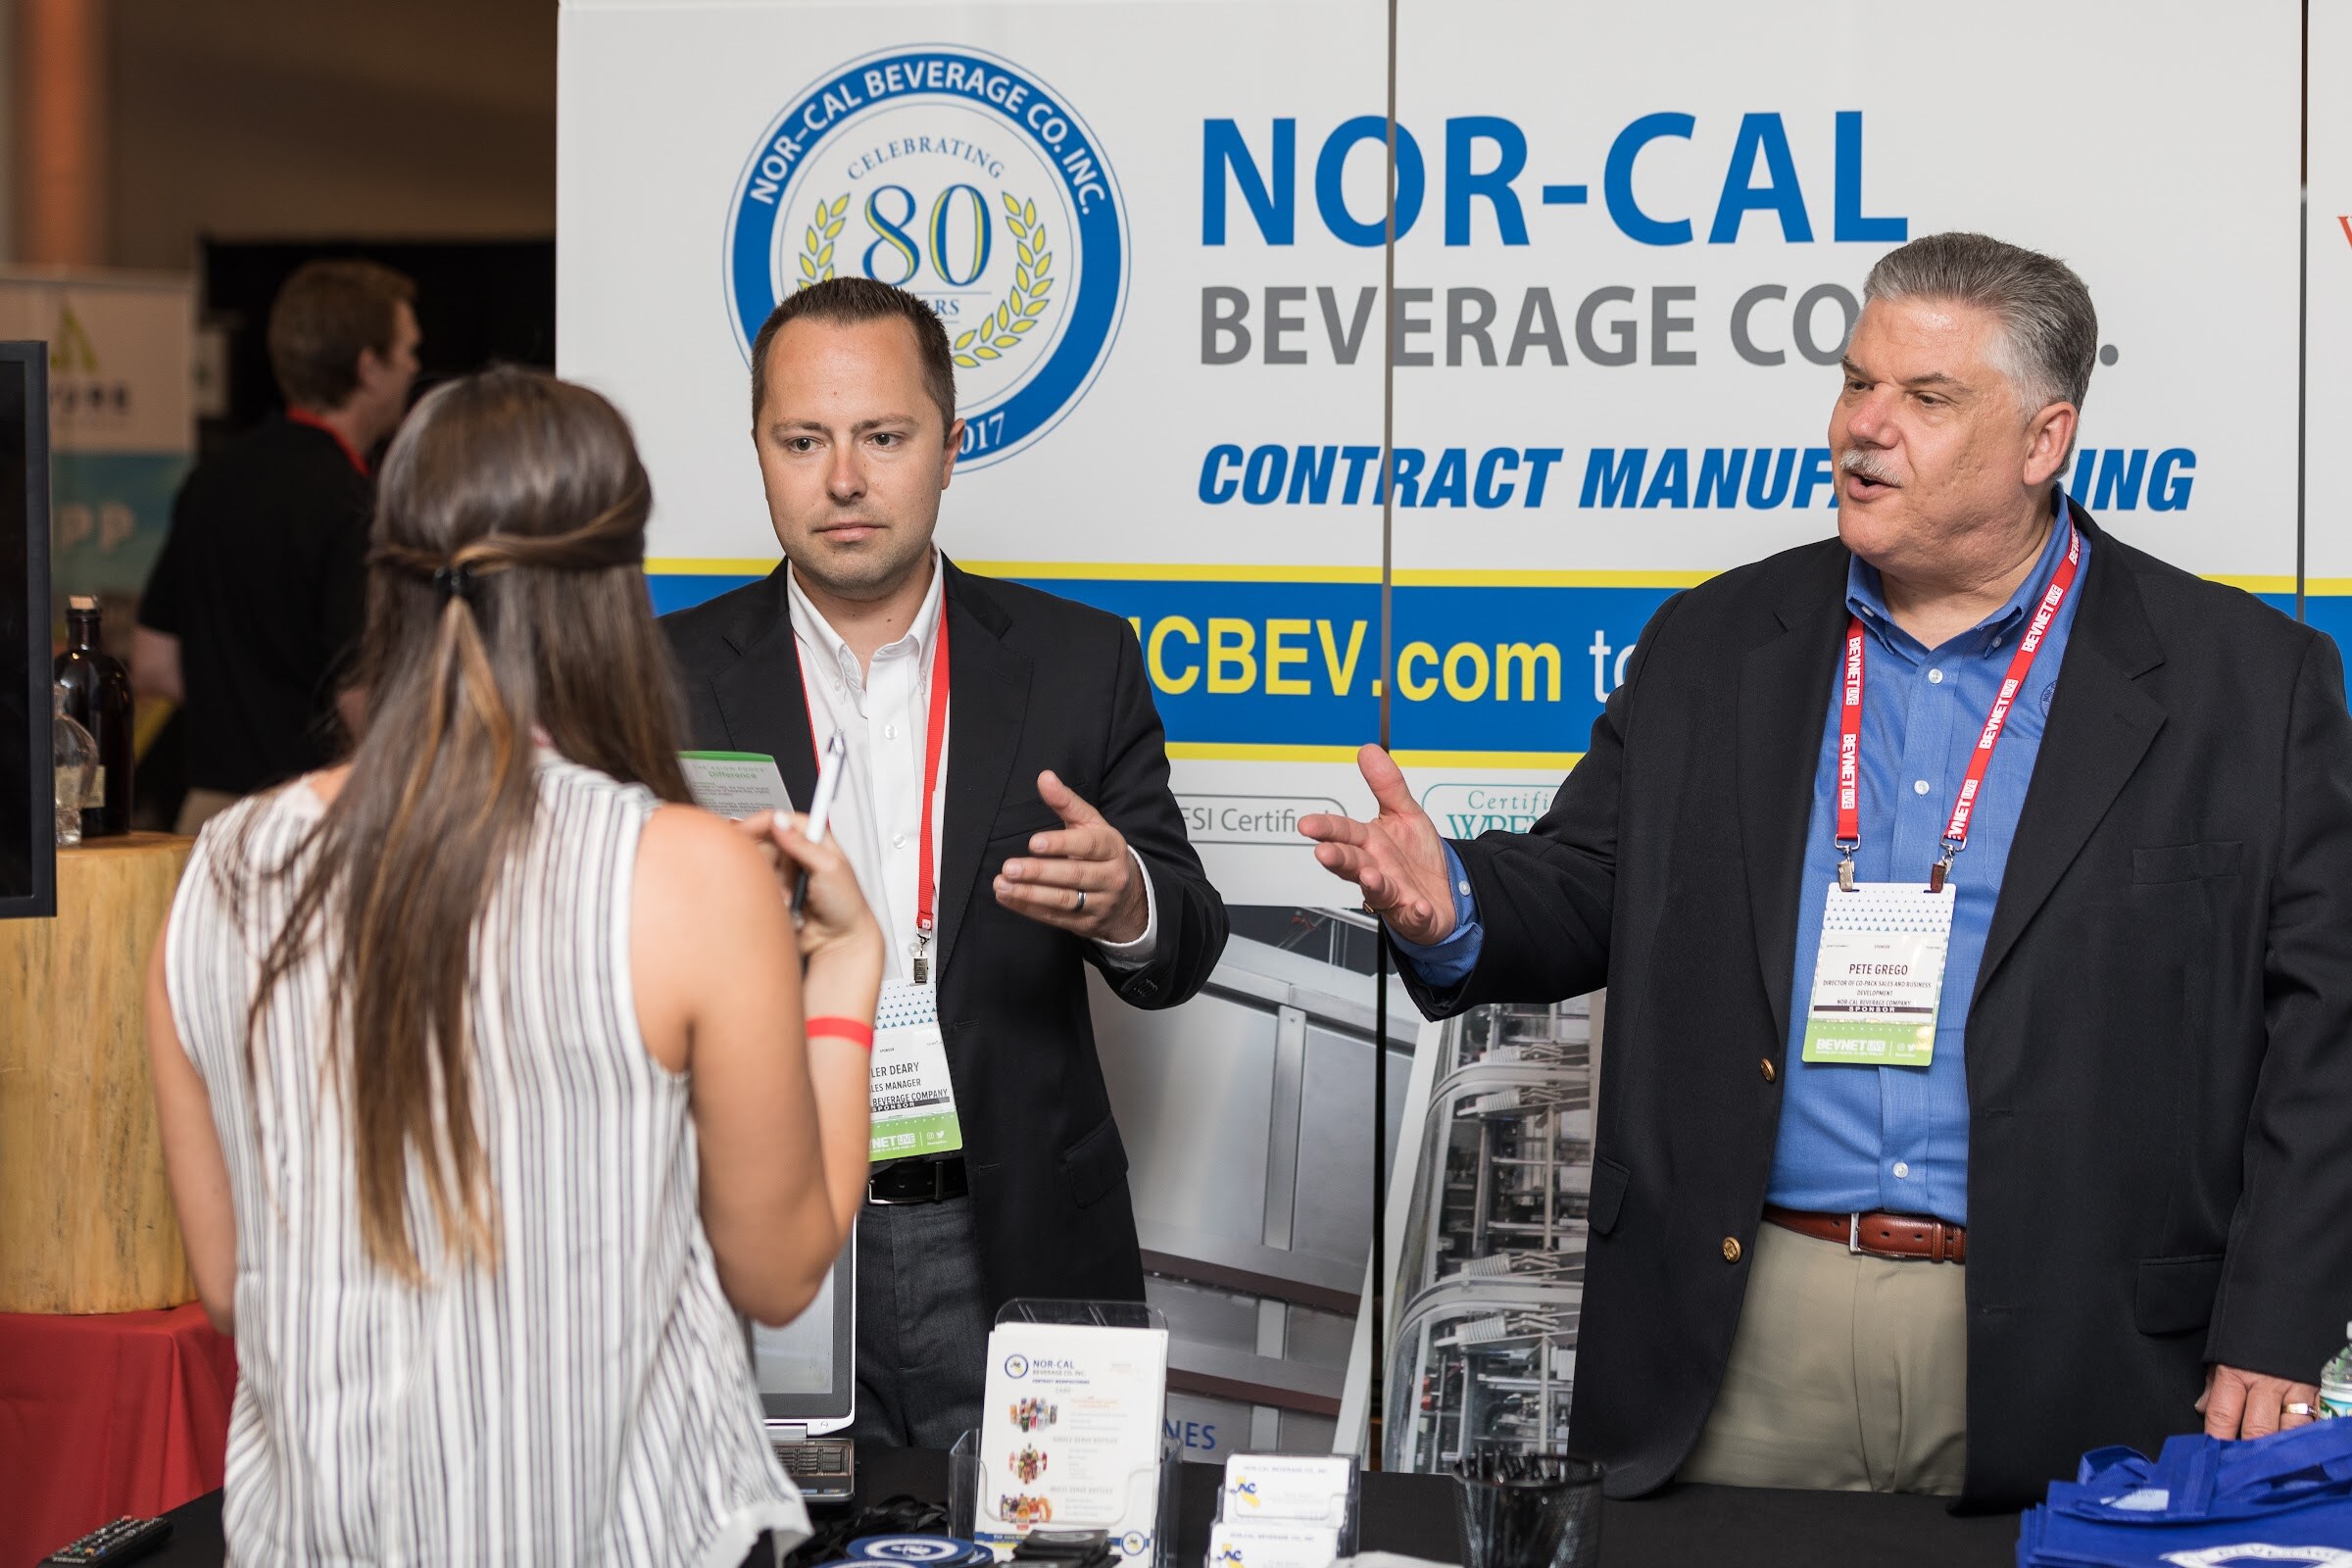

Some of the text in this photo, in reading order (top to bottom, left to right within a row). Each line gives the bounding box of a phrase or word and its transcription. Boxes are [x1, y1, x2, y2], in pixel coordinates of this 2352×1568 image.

[750, 61, 1105, 216] NOR-CAL BEVERAGE CO. INC.
[847, 136, 1005, 180] CELEBRATING
[1201, 110, 1909, 248] NOR-CAL
[862, 184, 992, 287] 80
[1200, 283, 1862, 368] BEVERAGE CO
[960, 412, 1005, 456] 017
[1198, 443, 2197, 514] CONTRACT MANUFING
[2021, 601, 2055, 653] BEVNET
[2044, 583, 2064, 607] LIVE
[1128, 614, 1562, 703] CBEV.com
[1845, 636, 1861, 706] BEVNET LIVE
[1979, 678, 2019, 750] BEVNET LIVE
[709, 770, 758, 779] Difference
[1841, 733, 1857, 810] BEVNET LIVE
[1221, 808, 1327, 832] Certifi
[1468, 790, 1548, 814] Certifi
[1948, 779, 1979, 840] VNET LIVE
[1848, 964, 1909, 976] PETE GREGO
[1816, 1038, 1867, 1052] BEVNET
[870, 1078, 921, 1093] LES MANAGER
[871, 1061, 919, 1078] LER DEARY
[872, 1088, 948, 1106] BEVERAGE COMPANY
[872, 1102, 915, 1112] SPONSOR
[870, 1135, 896, 1150] NET
[897, 1133, 915, 1146] LIVE
